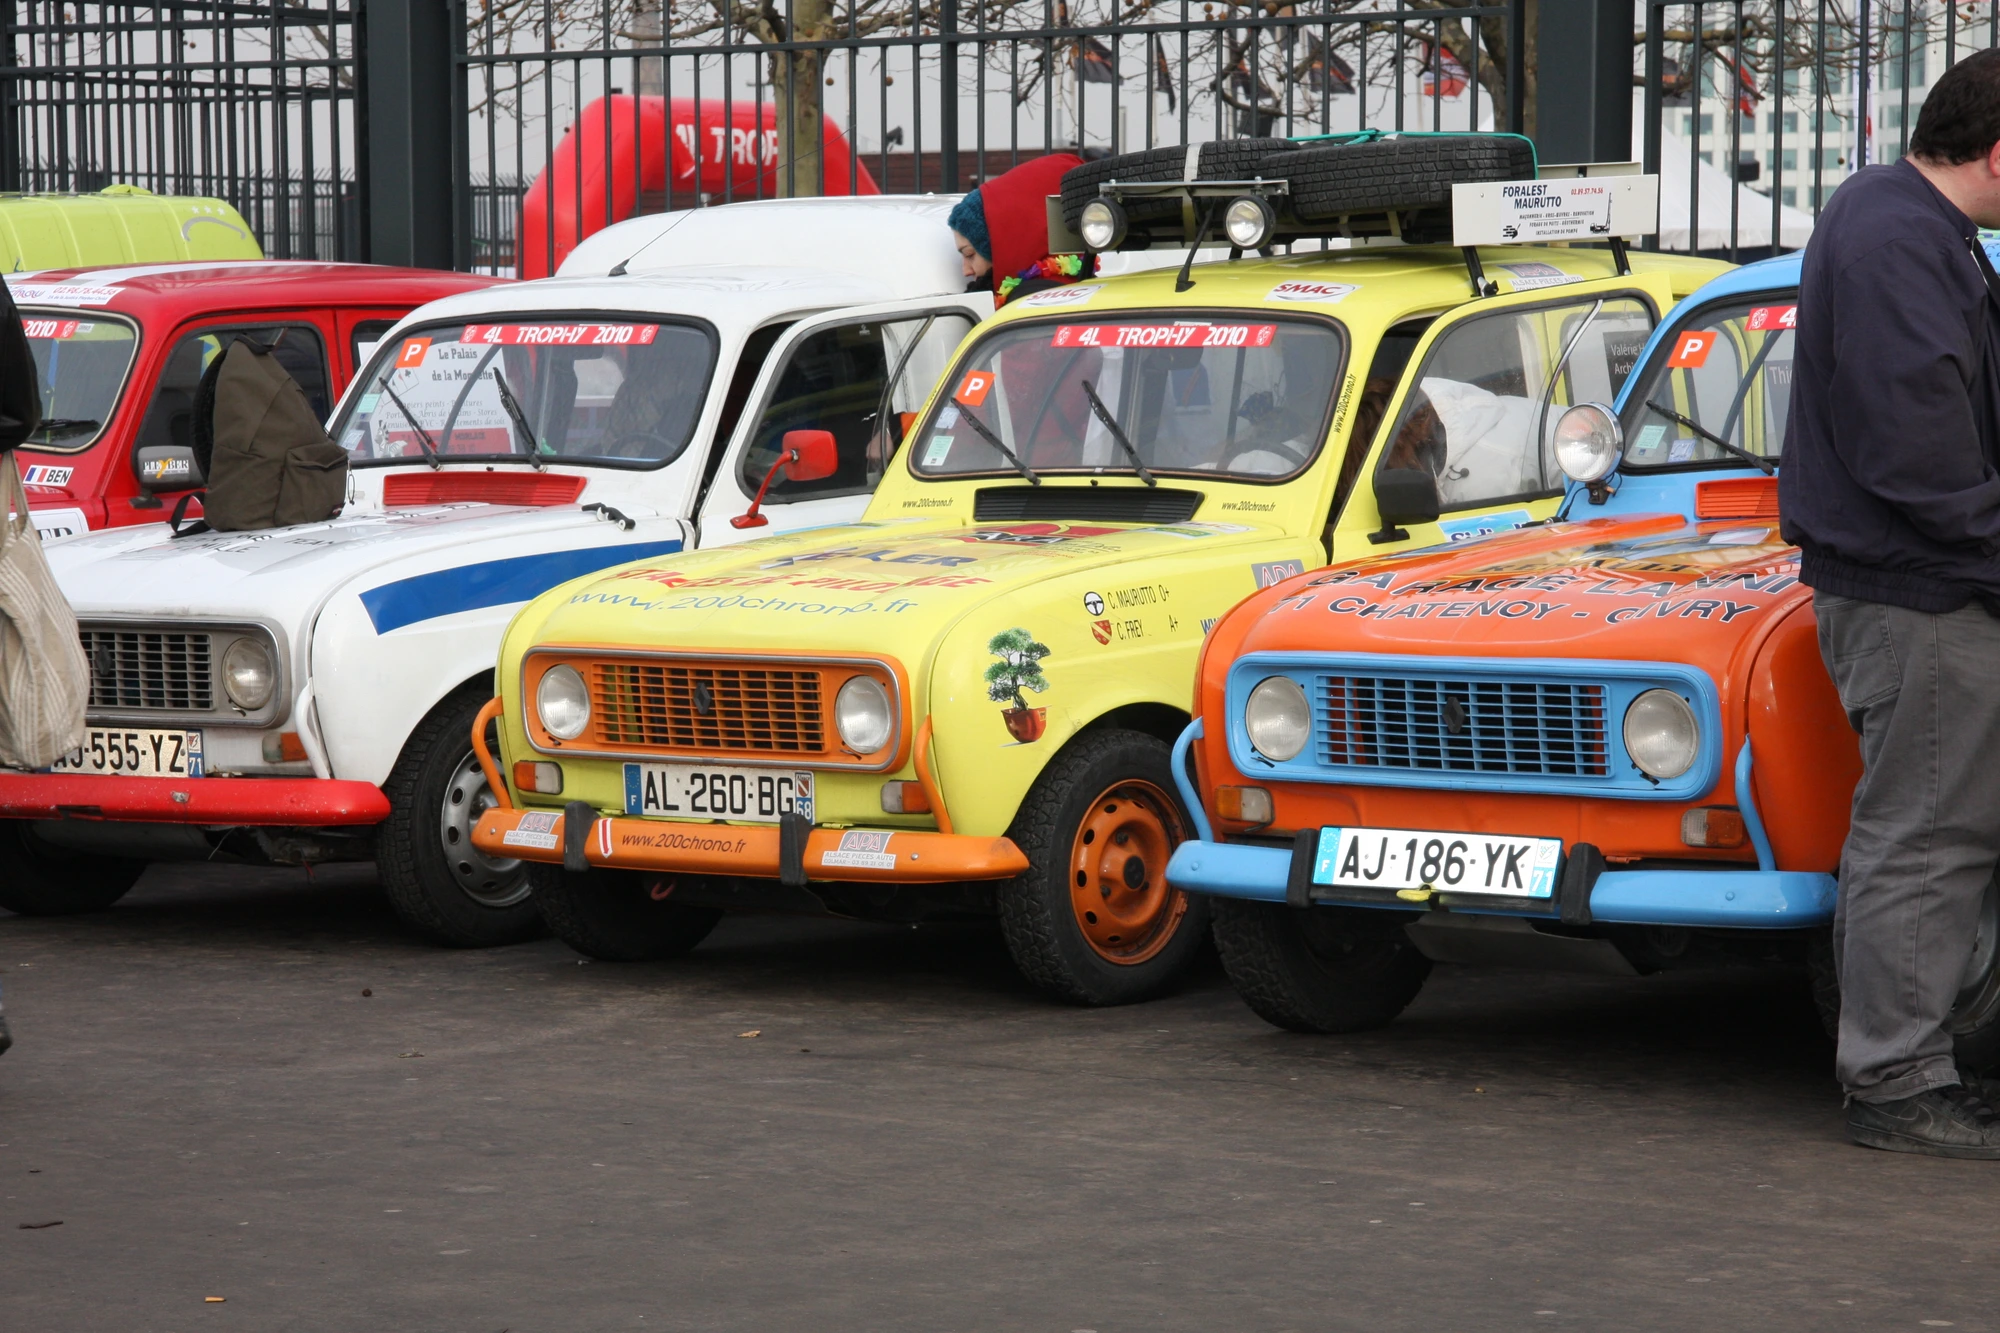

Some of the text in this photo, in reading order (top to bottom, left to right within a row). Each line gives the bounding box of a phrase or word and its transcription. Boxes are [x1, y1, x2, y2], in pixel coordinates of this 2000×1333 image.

[1502, 184, 1548, 197] FORALEST
[1514, 196, 1562, 209] MAURUTTO
[1026, 287, 1088, 301] SMAC
[1272, 283, 1342, 295] SMAC
[24, 320, 58, 338] 2010
[483, 326, 634, 343] 4L TROPHY 2010
[1078, 326, 1249, 345] 4L TROPHY 2010
[404, 344, 422, 361] P
[438, 347, 478, 360] Le Palais
[1610, 343, 1637, 356] Valérie
[1680, 338, 1703, 360] P
[432, 369, 493, 381] de la Moette
[964, 377, 984, 397] P
[1334, 373, 1357, 434] www.200chrono.fr
[46, 469, 71, 483] BEN
[1307, 570, 1577, 596] GARAGE
[570, 593, 919, 616] www.200chrono.fr
[1116, 585, 1157, 611] MAURUTTO
[1328, 597, 1571, 620] CHATENOY
[1605, 599, 1760, 625] GIVRY
[1127, 618, 1144, 639] FREY
[188, 757, 202, 776] 71
[630, 794, 637, 806] F
[644, 770, 794, 817] AL-260-BG
[796, 800, 812, 820] 68
[621, 833, 747, 853] www.200chrono.fr
[843, 832, 882, 851] APA
[824, 851, 850, 859] ALSACE
[851, 852, 875, 860] PIECES
[1339, 835, 1531, 889] AJ-186-YK
[1320, 860, 1329, 873] F
[1532, 870, 1553, 893] 71
